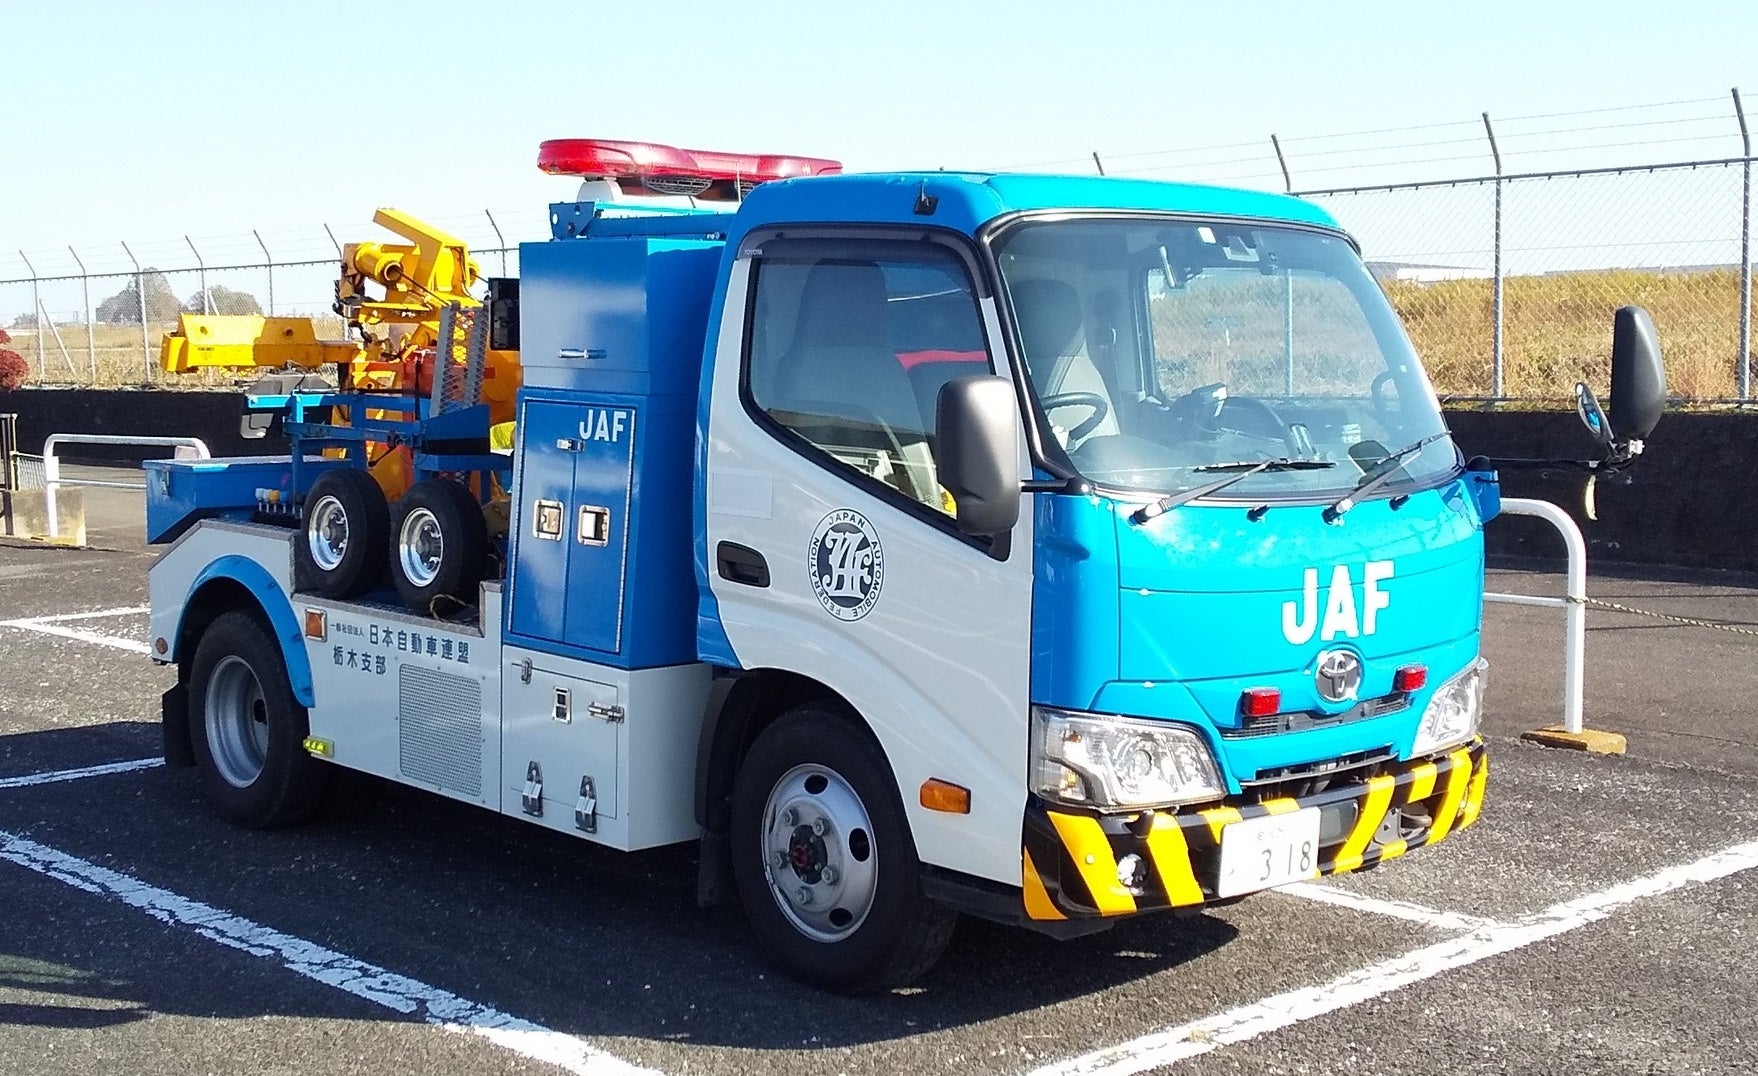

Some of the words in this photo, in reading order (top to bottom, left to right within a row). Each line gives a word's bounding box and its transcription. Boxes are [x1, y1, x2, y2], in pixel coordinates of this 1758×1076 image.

[579, 409, 627, 442] JAF
[828, 512, 865, 528] JAPAN
[811, 537, 842, 616] FEDERATION
[852, 541, 882, 617] AUTOMOBILE
[1281, 560, 1395, 645] JAF
[333, 645, 387, 675] 栃木支部
[369, 624, 470, 664] 日本自動車連盟
